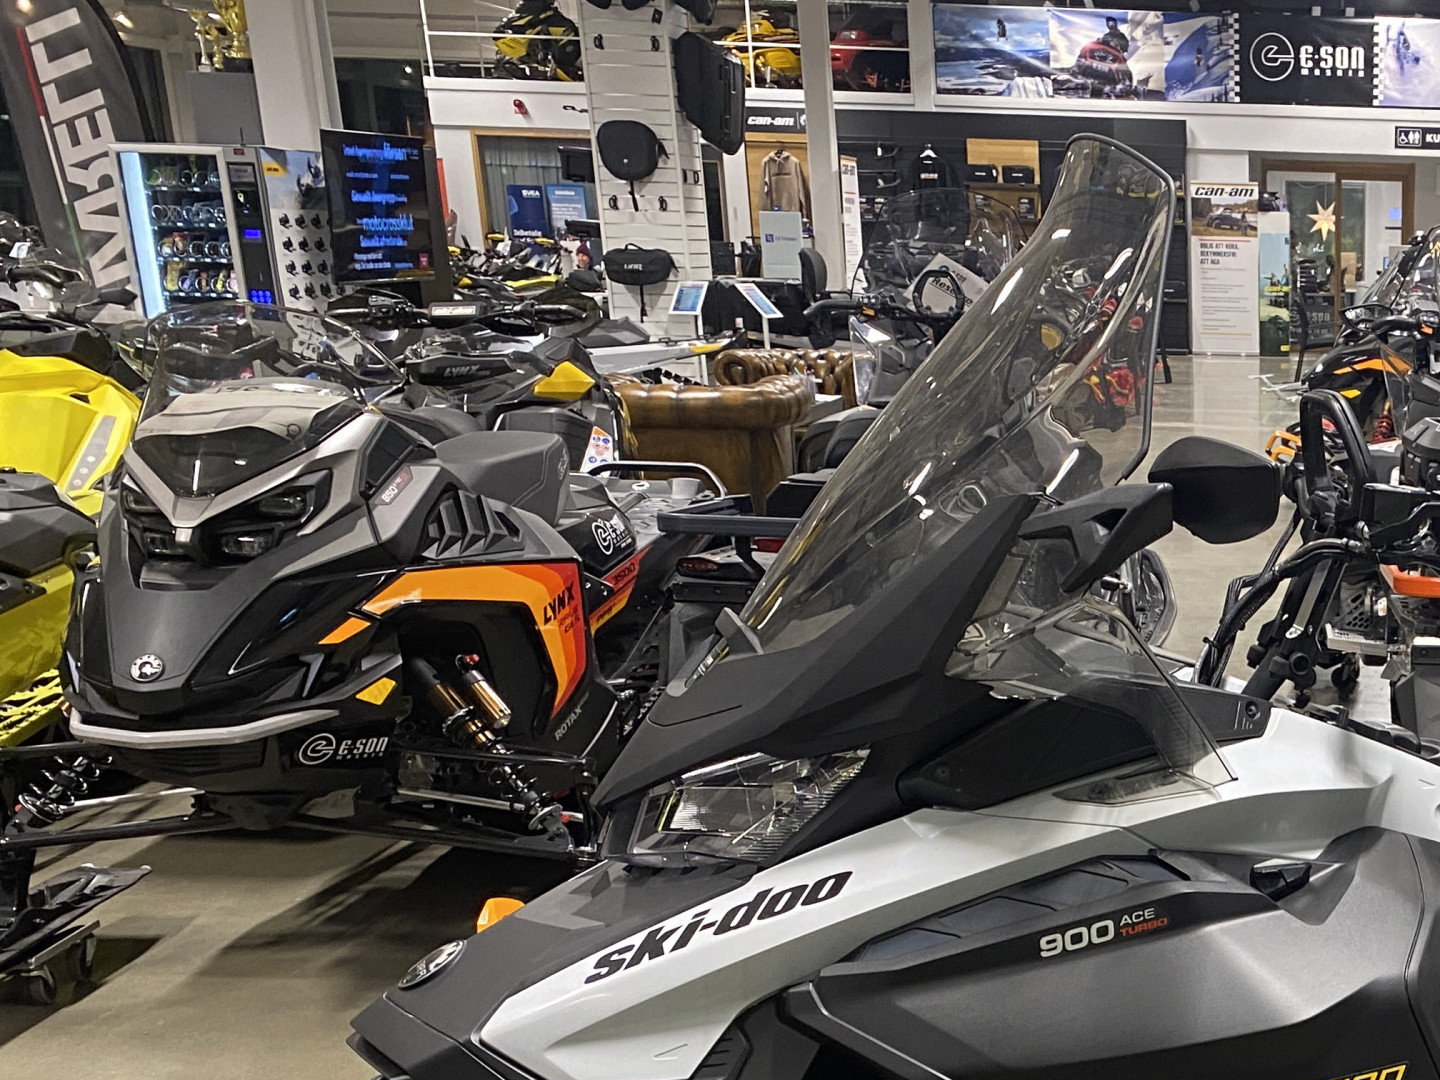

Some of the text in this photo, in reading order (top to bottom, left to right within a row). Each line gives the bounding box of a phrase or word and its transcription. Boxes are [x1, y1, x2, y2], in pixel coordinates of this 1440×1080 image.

[747, 115, 794, 126] can-am
[1194, 186, 1255, 198] can-am
[543, 582, 575, 626] LYNX
[554, 706, 583, 742] ROTAX
[1039, 908, 1156, 958] 900 ACE
[1120, 917, 1169, 937] TURBO
